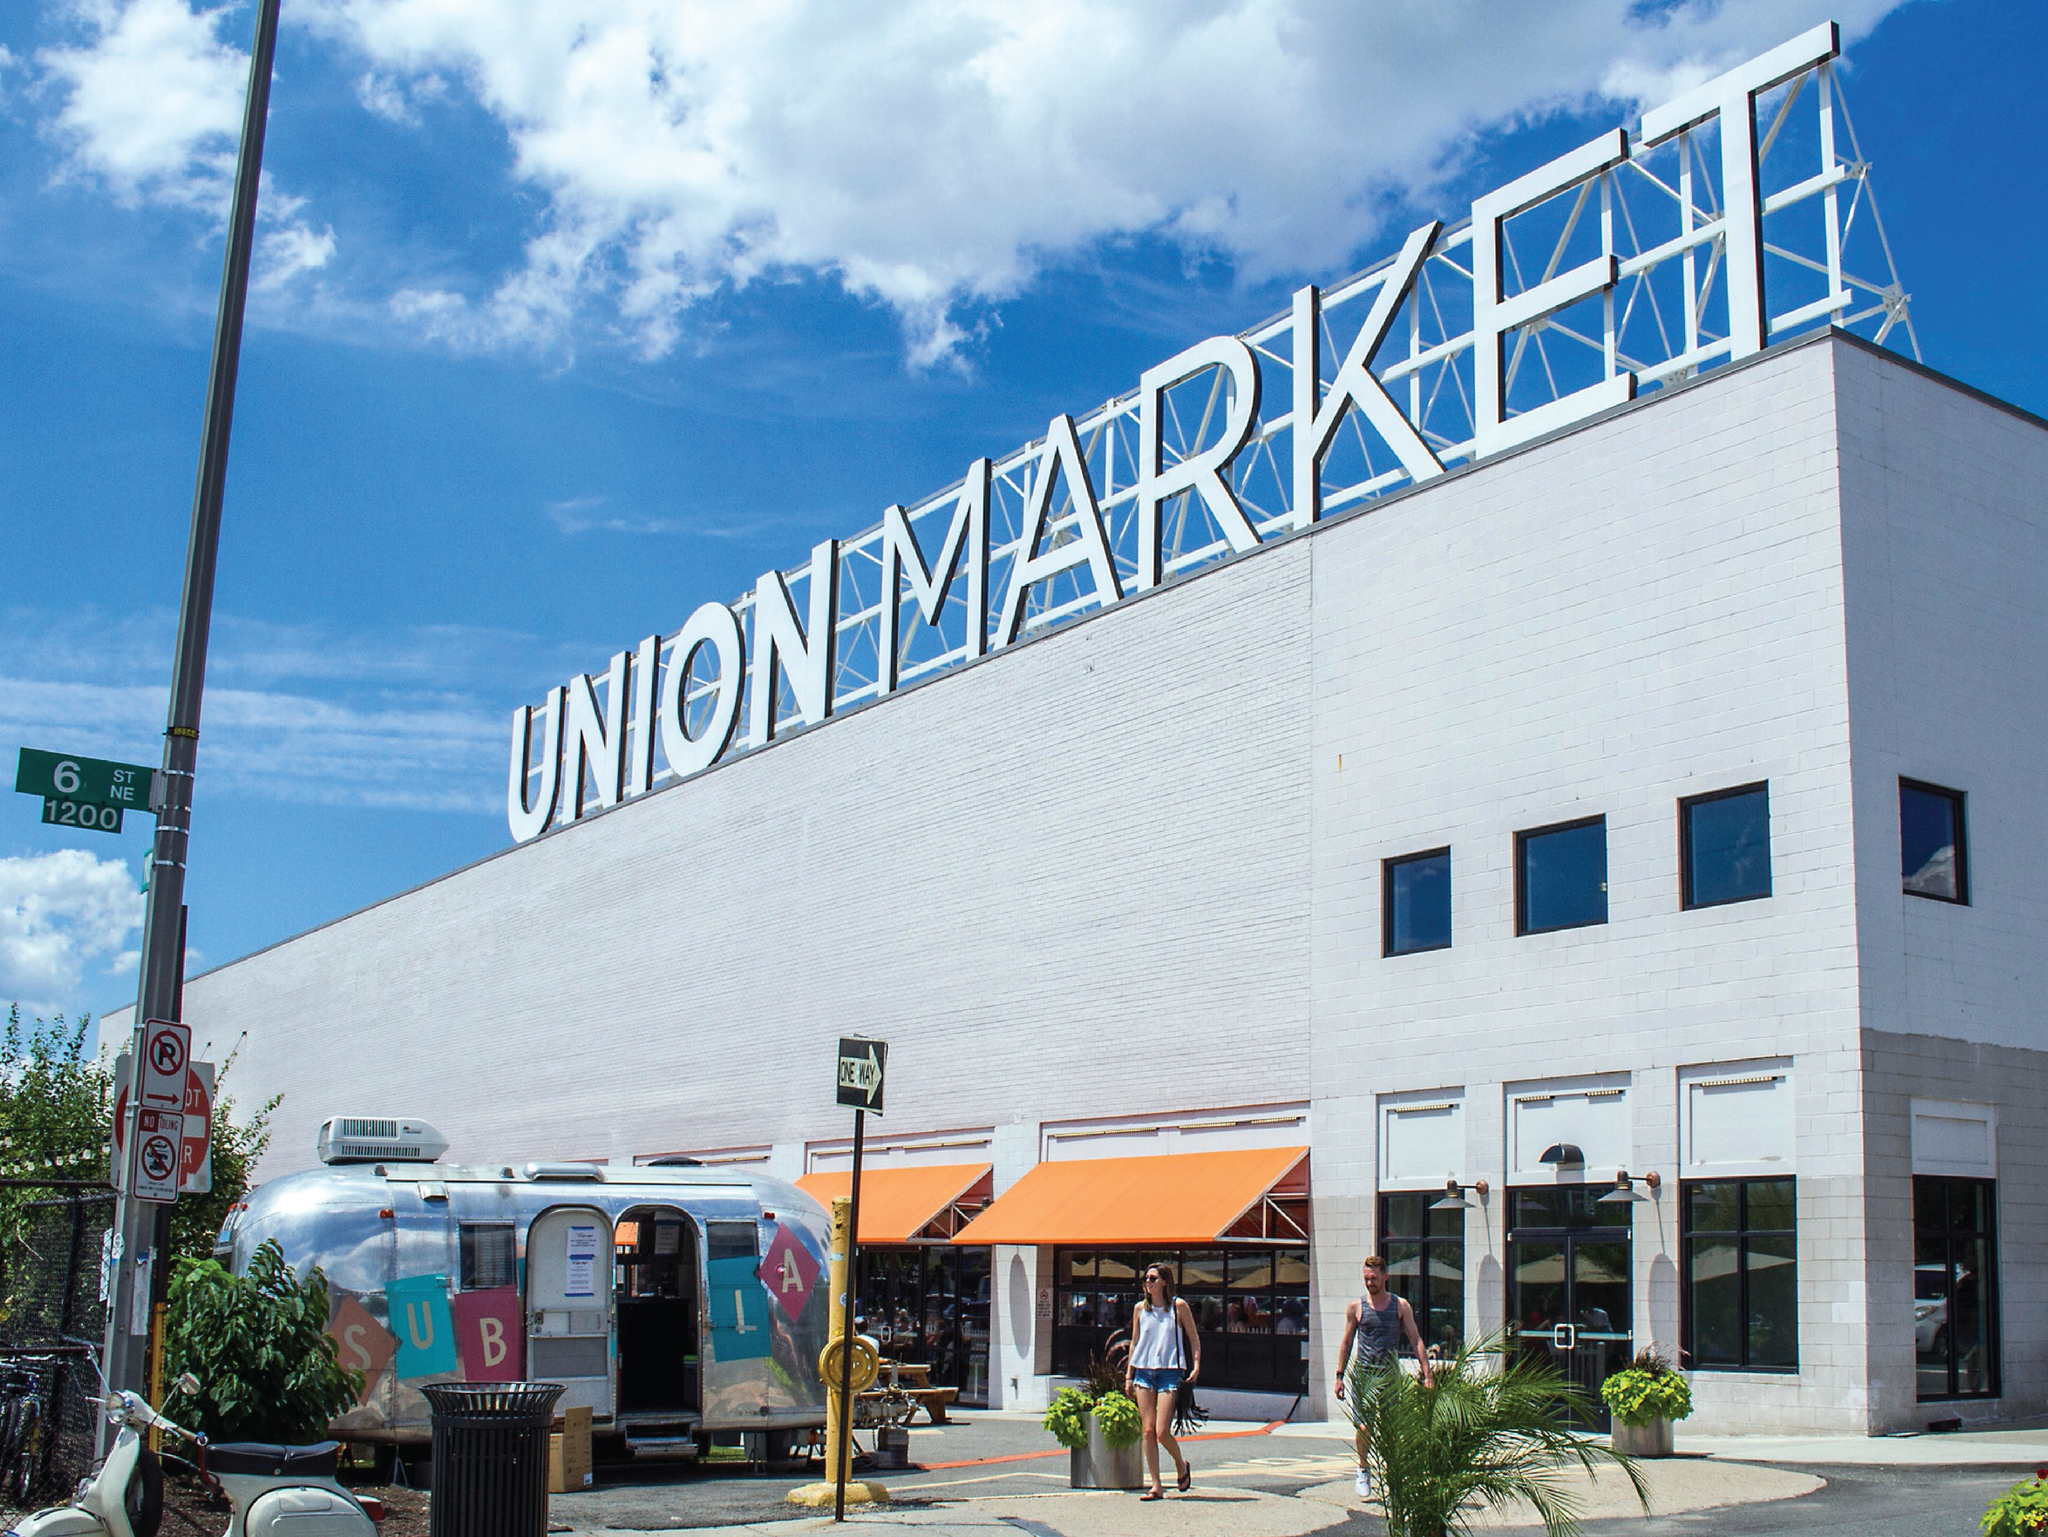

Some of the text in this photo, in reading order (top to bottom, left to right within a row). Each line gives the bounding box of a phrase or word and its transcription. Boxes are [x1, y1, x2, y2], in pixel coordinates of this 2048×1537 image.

[507, 21, 1840, 844] UNION MARKET
[54, 761, 135, 793] 6 ST
[110, 785, 135, 801] NE
[46, 800, 118, 829] 1200
[841, 1061, 876, 1085] ONE WAY
[144, 1115, 155, 1128] NO
